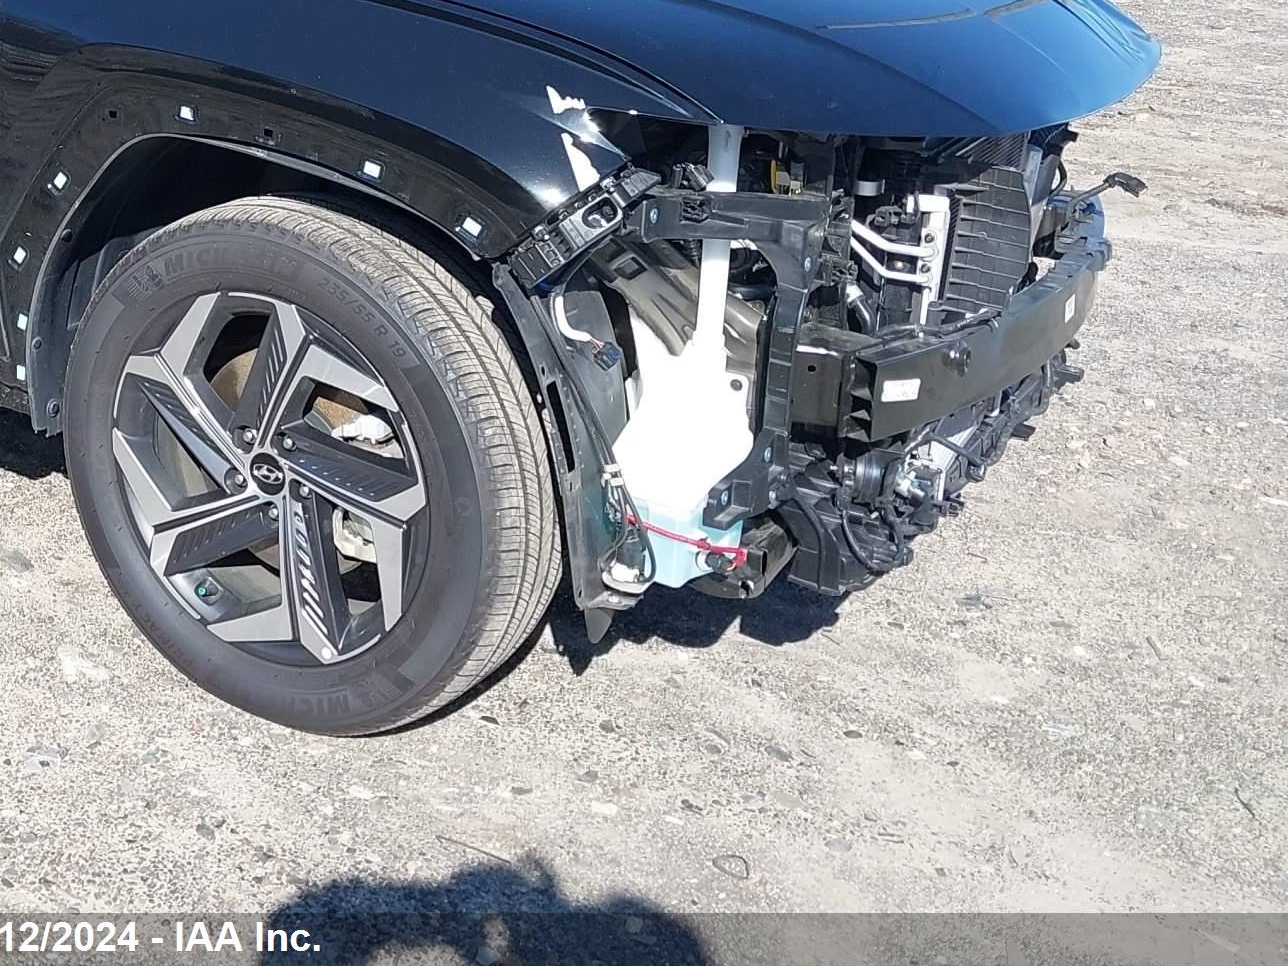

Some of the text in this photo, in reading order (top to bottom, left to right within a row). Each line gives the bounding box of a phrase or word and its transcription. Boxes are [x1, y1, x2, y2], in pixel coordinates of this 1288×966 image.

[318, 277, 375, 323] 235/55
[374, 324, 388, 337] R
[389, 339, 406, 358] 19
